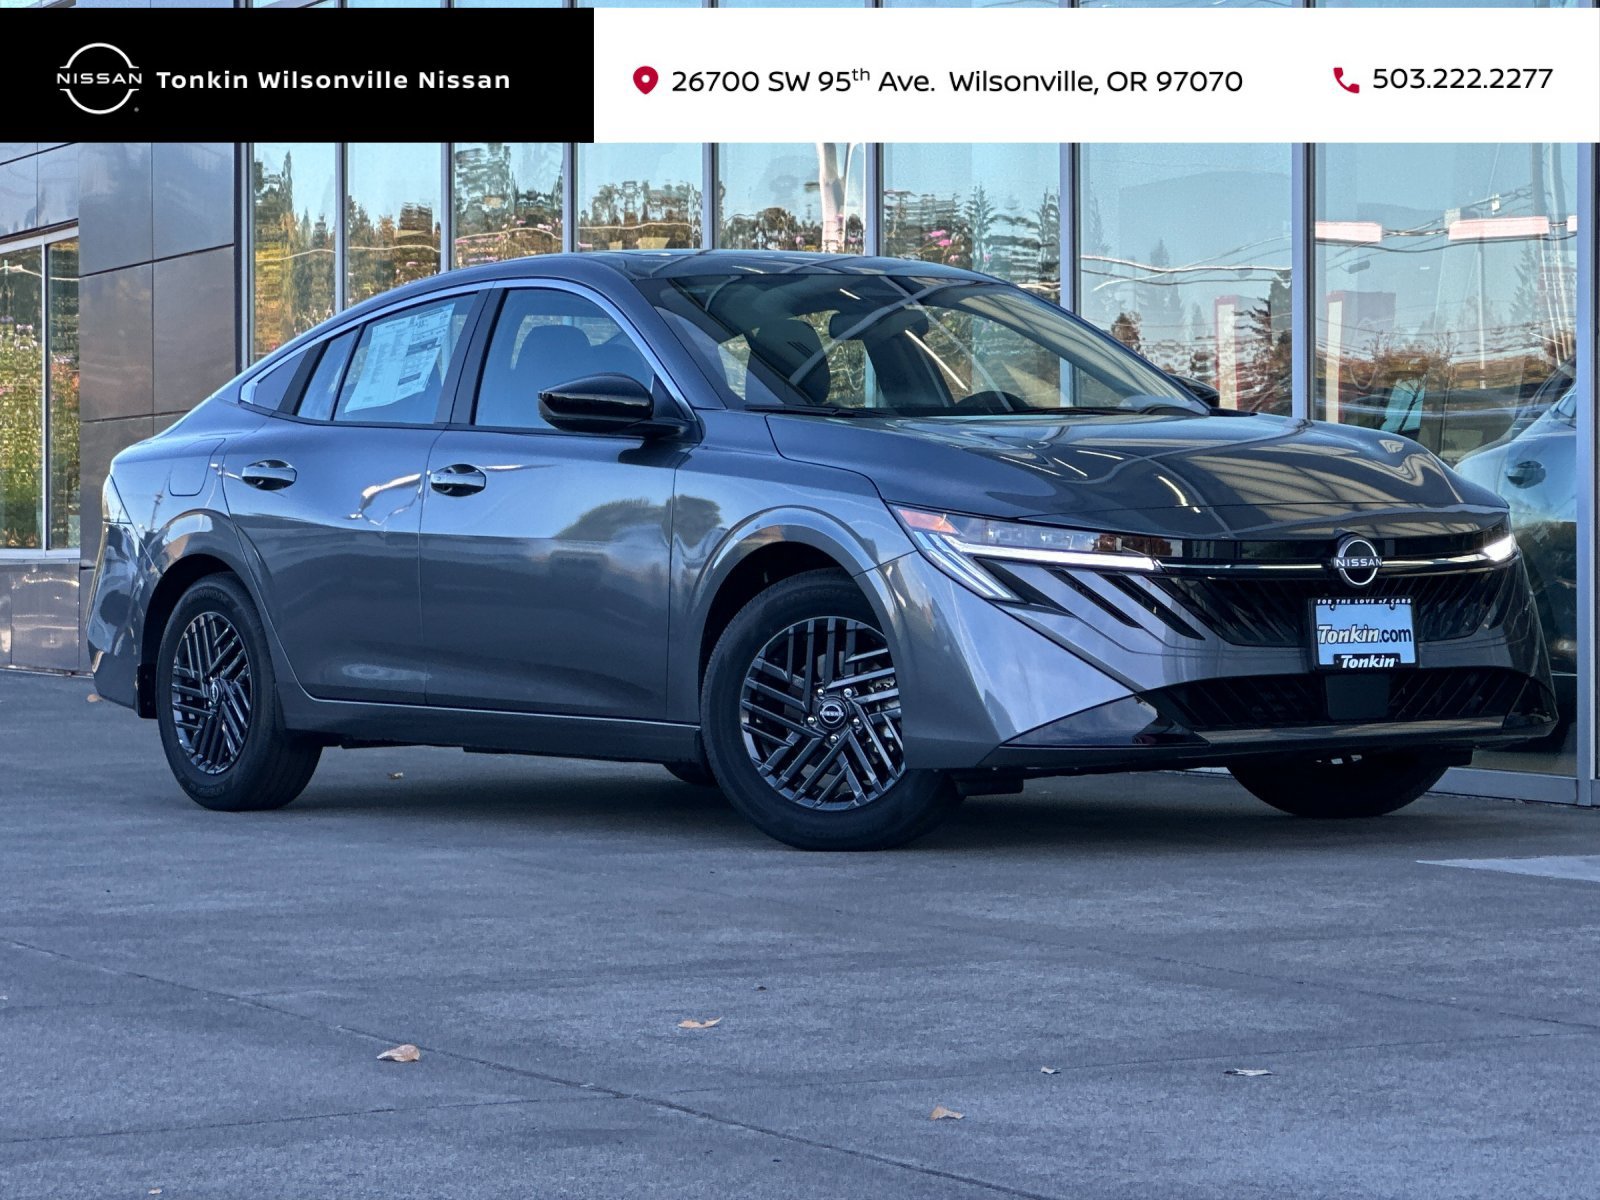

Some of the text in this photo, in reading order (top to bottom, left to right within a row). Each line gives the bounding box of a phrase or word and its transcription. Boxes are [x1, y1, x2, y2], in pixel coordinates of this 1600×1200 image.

[1335, 557, 1382, 567] NISSAN
[1317, 624, 1412, 645] Tonkin.com
[1340, 655, 1395, 669] Tonkin
